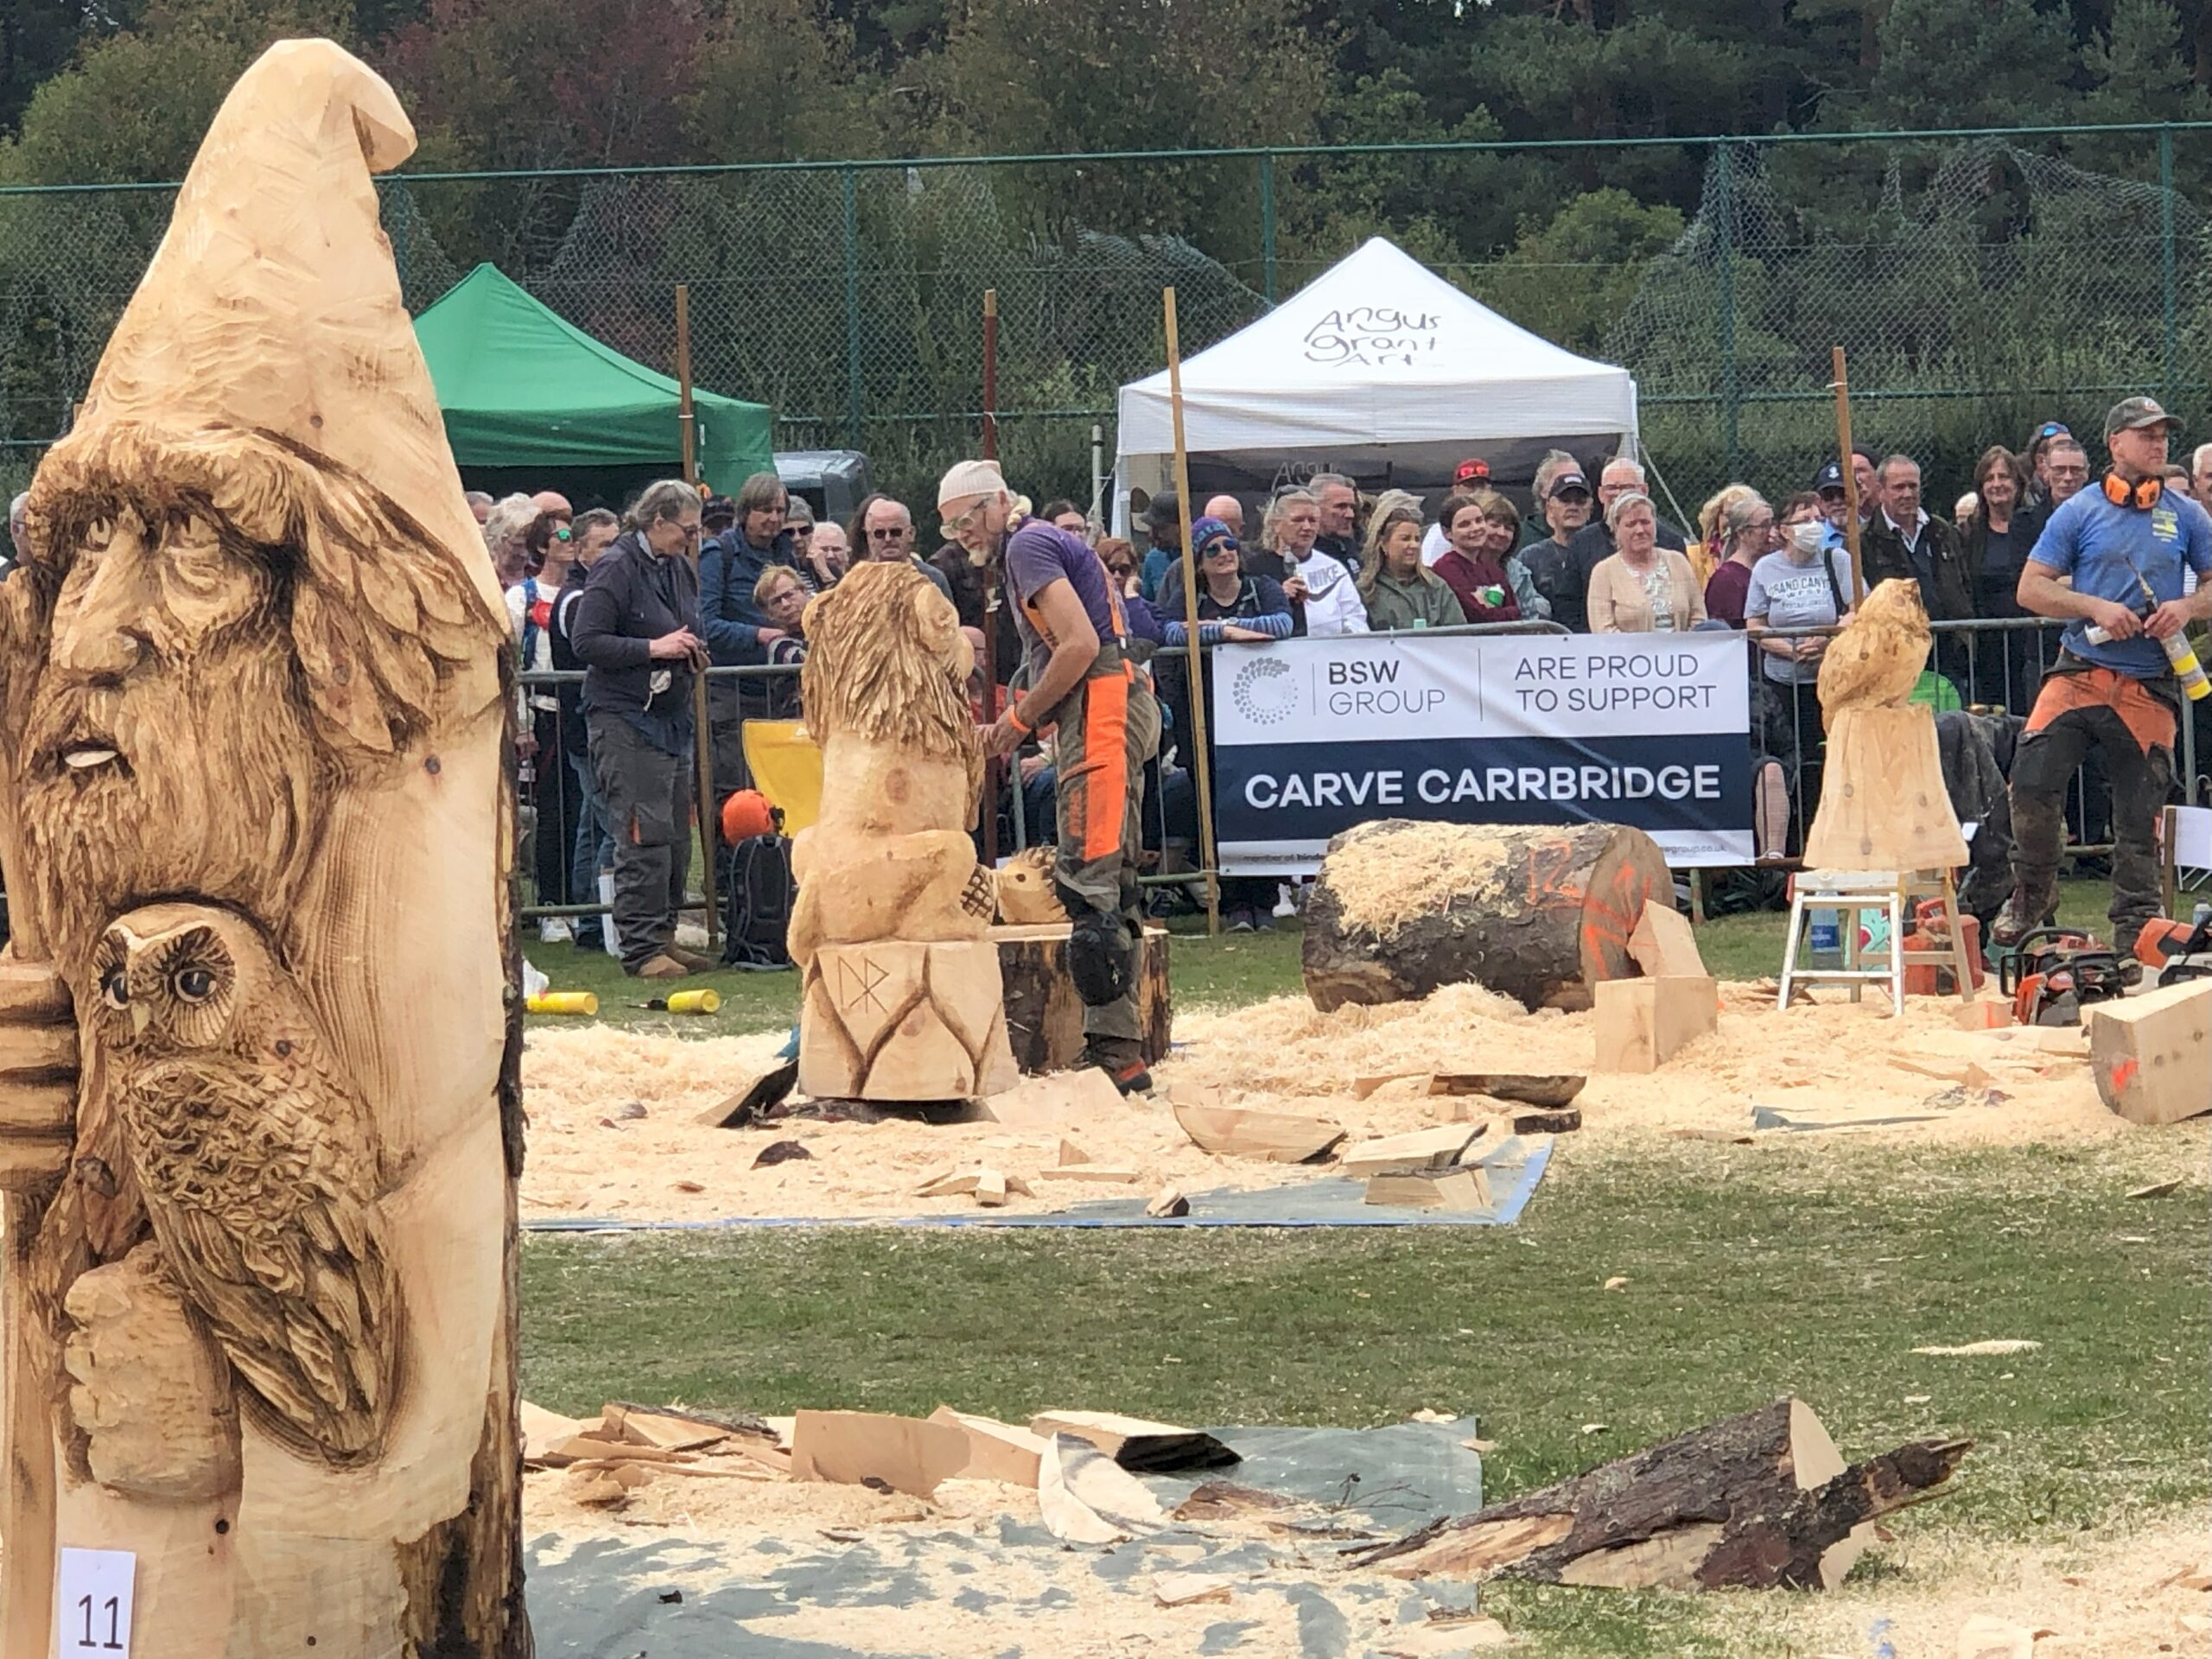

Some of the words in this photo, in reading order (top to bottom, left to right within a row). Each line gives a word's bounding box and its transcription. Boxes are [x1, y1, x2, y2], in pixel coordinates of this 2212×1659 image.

[1307, 563, 1338, 588] NIKE
[1328, 660, 1400, 685] BSW
[1515, 657, 1577, 681] ARE
[1588, 654, 1700, 679] PROUD
[1328, 689, 1446, 715] GROUP
[1516, 689, 1558, 712] TO
[1568, 684, 1718, 711] SUPPORT
[1244, 771, 1404, 809] CARVE
[1416, 764, 1721, 804] CARRBRIDGE
[79, 1594, 124, 1649] 11
